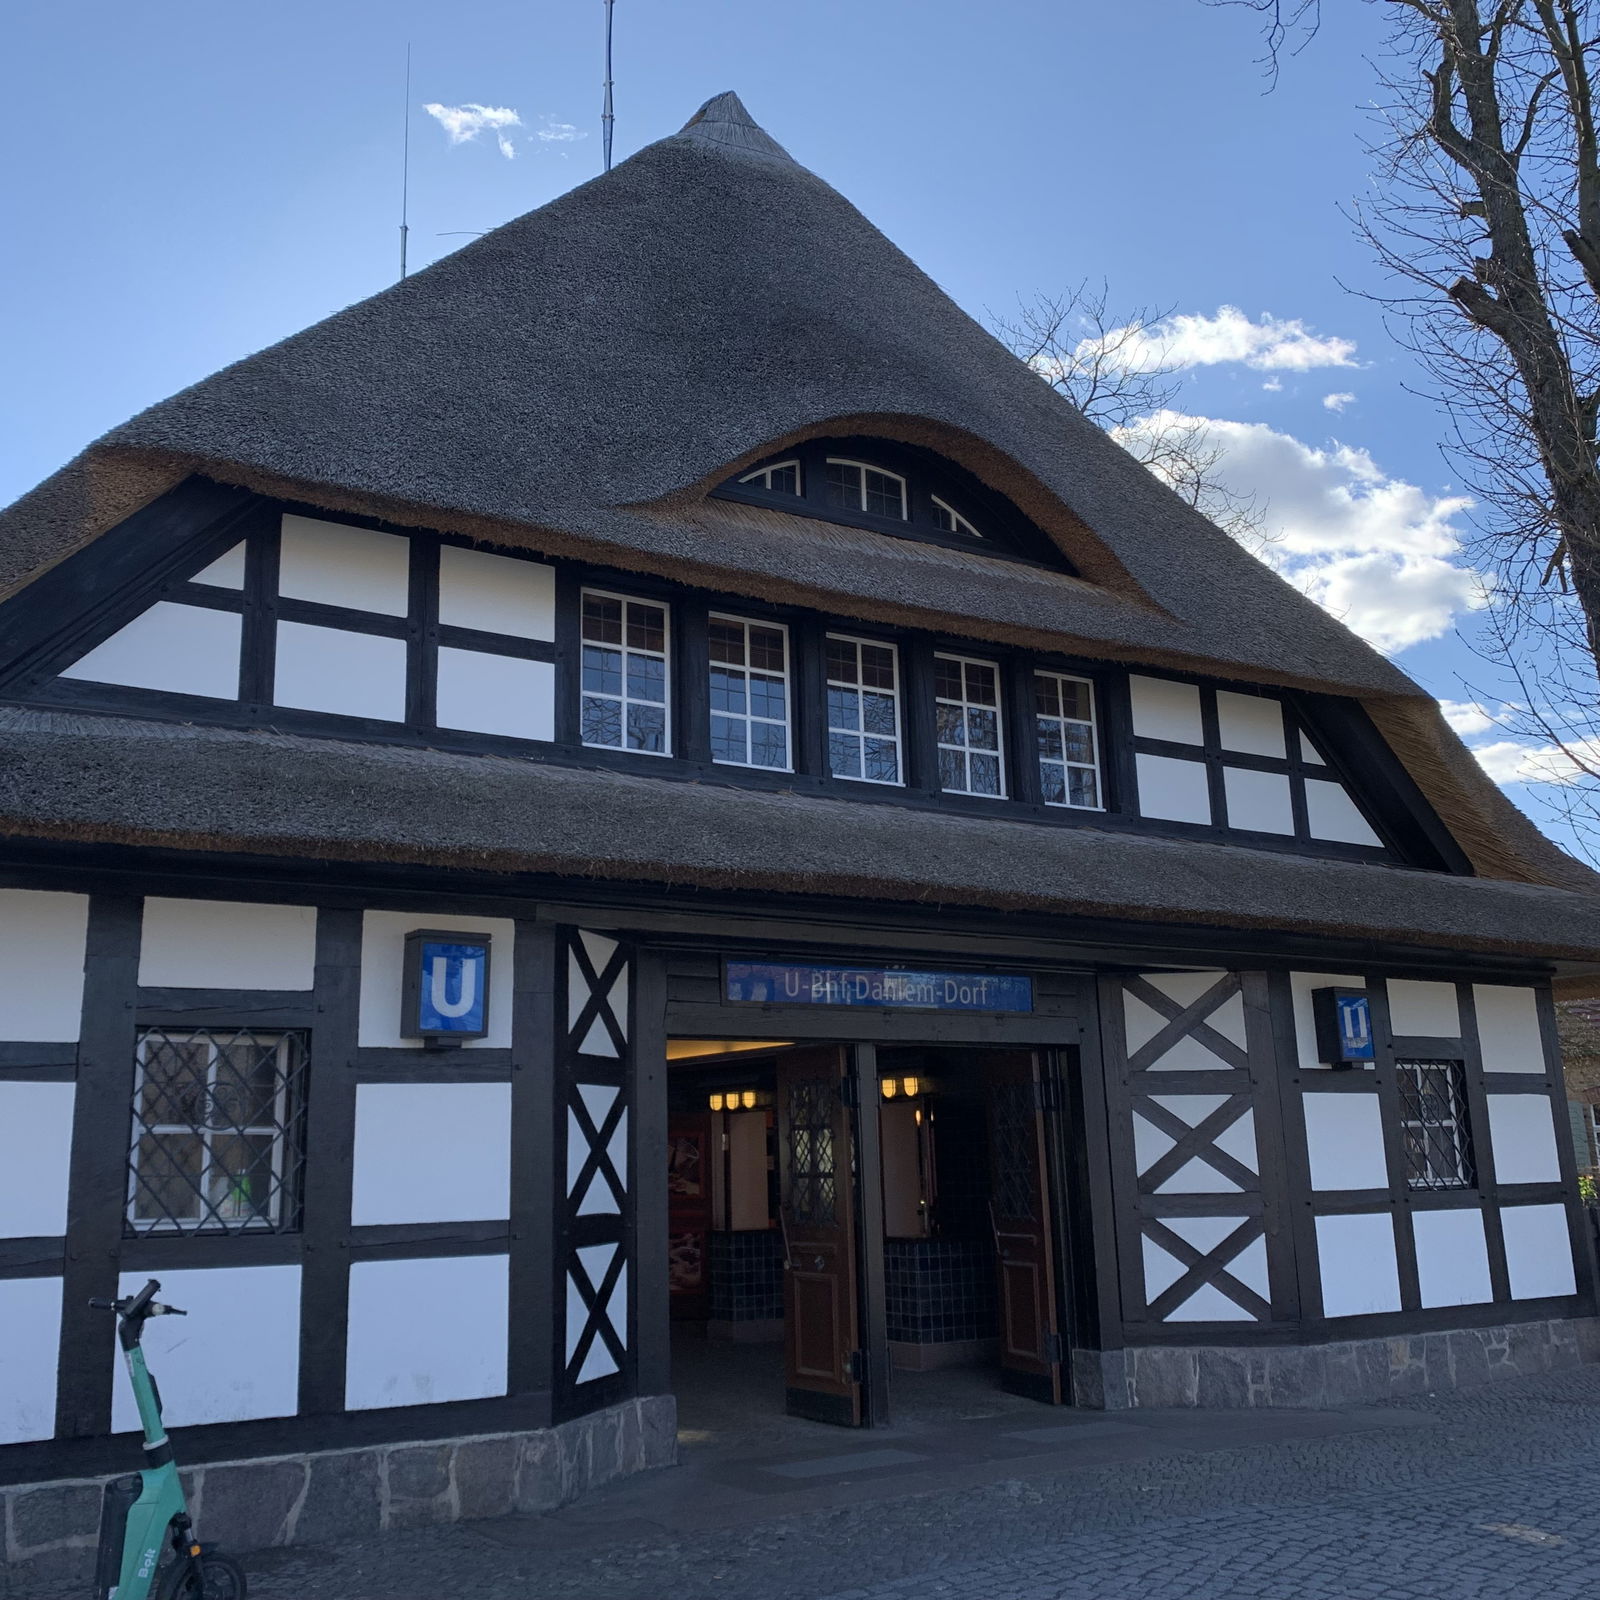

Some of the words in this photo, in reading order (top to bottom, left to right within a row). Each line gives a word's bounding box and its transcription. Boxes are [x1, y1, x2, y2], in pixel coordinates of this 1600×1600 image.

[431, 956, 476, 1018] U
[855, 974, 988, 1005] Dahlem-Dorf
[1343, 1006, 1368, 1049] U
[138, 1548, 156, 1578] Bolt
